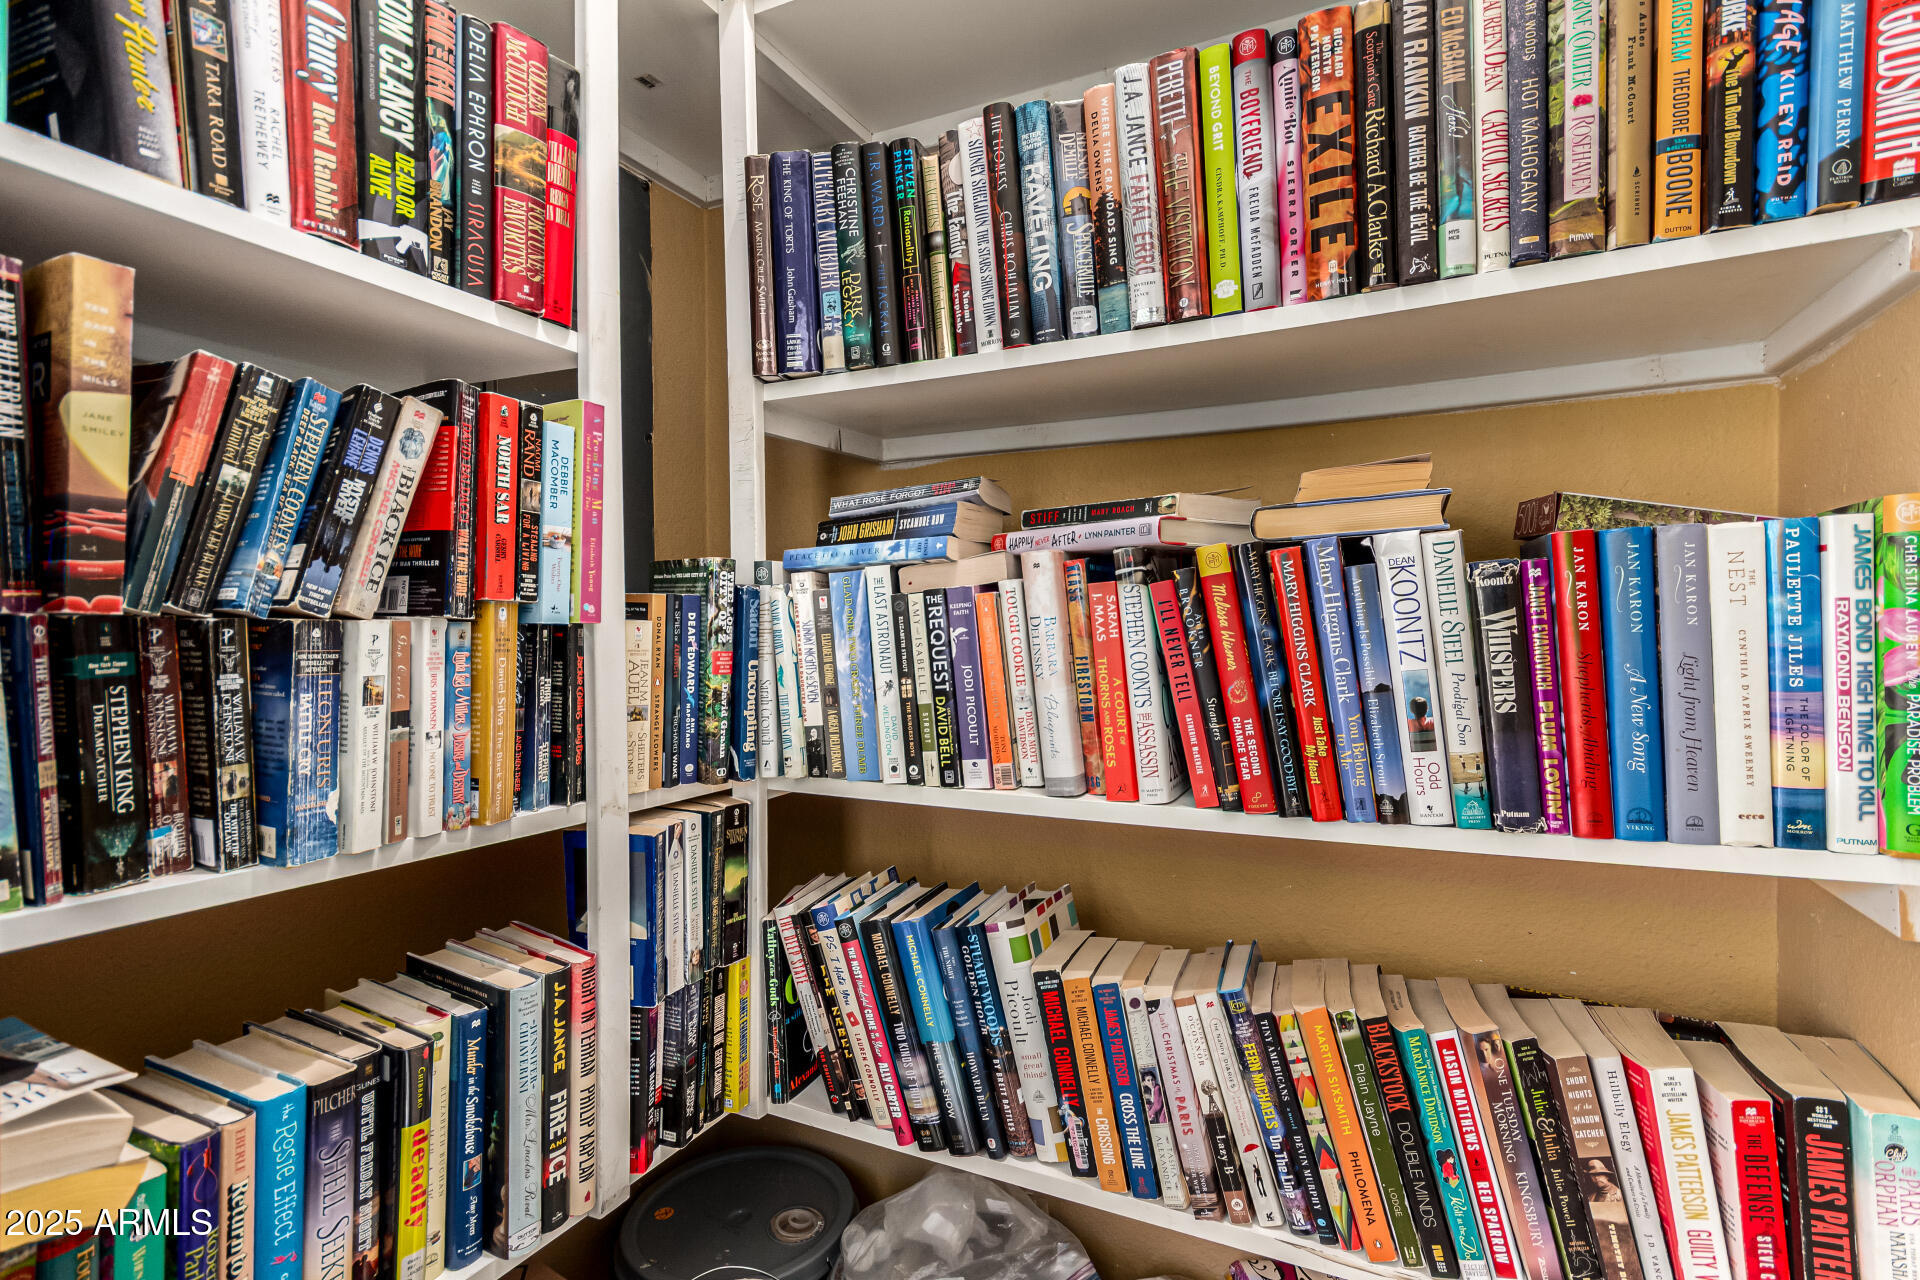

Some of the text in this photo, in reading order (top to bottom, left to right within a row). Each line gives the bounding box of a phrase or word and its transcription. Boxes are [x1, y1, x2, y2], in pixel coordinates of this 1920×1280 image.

[296, 0, 347, 103] Clancy
[1310, 25, 1321, 93] PATTERSON
[1323, 35, 1333, 75] NORTH
[1333, 27, 1343, 78] RICHARD
[1567, 30, 1598, 90] COULTER
[1835, 2, 1856, 149] MATTHEW PERRY
[205, 61, 228, 168] TARA ROAD
[378, 44, 414, 152] CLANCY
[1208, 65, 1224, 151] BEYOND GRIT
[1239, 69, 1263, 181] THE BOYFRIEND
[1776, 68, 1796, 187] KILEY REID
[312, 101, 339, 220] Red Rabbit
[369, 153, 392, 200] ALIVE
[467, 25, 487, 287] DELIA EPHRON SIRACUSA
[893, 151, 905, 201] PINKER
[904, 149, 916, 199] STEVEN
[1100, 96, 1118, 266] WHERE THE CRAWDADS SING
[1307, 90, 1354, 254] EXILE
[1569, 114, 1595, 196] ROSEHAVEN
[1665, 68, 1694, 218] THEODORE BOONE
[395, 151, 416, 219] DEAD OR
[782, 157, 795, 254] THE KING OF TORTS
[1248, 186, 1260, 223] FREIDA
[902, 209, 914, 264] Rationality
[1569, 231, 1594, 242] PUTNAM
[1664, 225, 1692, 234] DUTTON
[786, 266, 796, 288] John
[786, 289, 797, 324] Grisham
[81, 411, 113, 423] JANE
[81, 424, 125, 438] SMILEY
[550, 439, 560, 510] MACOMBER
[559, 456, 568, 496] DEBBIE
[837, 524, 858, 542] JOHN
[859, 518, 895, 539] GRISHAM
[899, 514, 945, 530] SYCAMORE ROW
[1008, 530, 1078, 551] HAPPILY NEVER AFTER
[1030, 511, 1059, 525] STIFF
[1084, 526, 1136, 540] LYNN PAINTER
[925, 595, 943, 604] THE
[1388, 555, 1415, 567] DEAN
[1627, 542, 1643, 633] JAN KARON
[1854, 524, 1873, 654] JAMES BOND
[950, 601, 972, 610] KEEPING
[1005, 588, 1027, 687] TOUGH COOKIE
[1282, 560, 1316, 709] MARY HIGGINS CLARK
[1388, 566, 1427, 665] KOONTZ
[1432, 540, 1464, 668] DANIELLE STEEL
[1785, 527, 1804, 688] PAULETTE JILES
[685, 612, 696, 694] DEAR EDWARD
[927, 604, 950, 692] REQUEST
[1158, 600, 1193, 703] I'LL NEVER TELL
[1479, 606, 1517, 715] WHISPERS
[1836, 600, 1853, 772] RAYMOND BENSON
[936, 696, 951, 768] DAVID BELL
[961, 665, 979, 747] JODI PICOULT
[1623, 663, 1651, 773] A New Song
[1738, 629, 1748, 680] CYNTHIA
[1743, 735, 1754, 787] SWEENEY
[93, 704, 107, 804] DREAMCATCHER
[110, 685, 135, 815] STEPHEN KING
[1539, 701, 1563, 820] PLUM LOVIN'
[1499, 810, 1530, 819] Putnam
[1836, 838, 1878, 846] PUTNAM
[552, 982, 567, 1074] J.A. JANCE
[1005, 979, 1028, 1044] Picoult
[1021, 995, 1038, 1025] Jodi
[1042, 991, 1061, 1043] MICHAEL
[1052, 1046, 1080, 1107] CONNELLY
[1103, 1008, 1120, 1037] JAMES
[313, 1084, 356, 1117] PILCHER
[578, 965, 595, 1185] NIGHT IN TEHRAN PHILIP KAPLAN
[1110, 1037, 1131, 1086] PATTERSON
[1314, 1024, 1352, 1136] MARTIN SIXSMITH
[1353, 1063, 1380, 1137] Plain Jayne
[1442, 1048, 1480, 1151] JASON MATTHEWS
[549, 1088, 567, 1189] FIRE AND ICE
[1095, 1117, 1116, 1166] CROSSING
[1119, 1093, 1146, 1169] CROSS THE LINE
[1366, 1022, 1437, 1228] BLACKSTOCK DOUBLE MINDS
[1607, 1071, 1632, 1153] Hillbilly Elegy
[1745, 1134, 1762, 1150] THE
[272, 1103, 298, 1247] the Rosie Effect
[404, 1128, 427, 1228] deadly
[1348, 1151, 1377, 1227] PHILOMENA
[1743, 1154, 1775, 1223] DEFENSE
[1476, 1181, 1509, 1264] RED SPARROW
